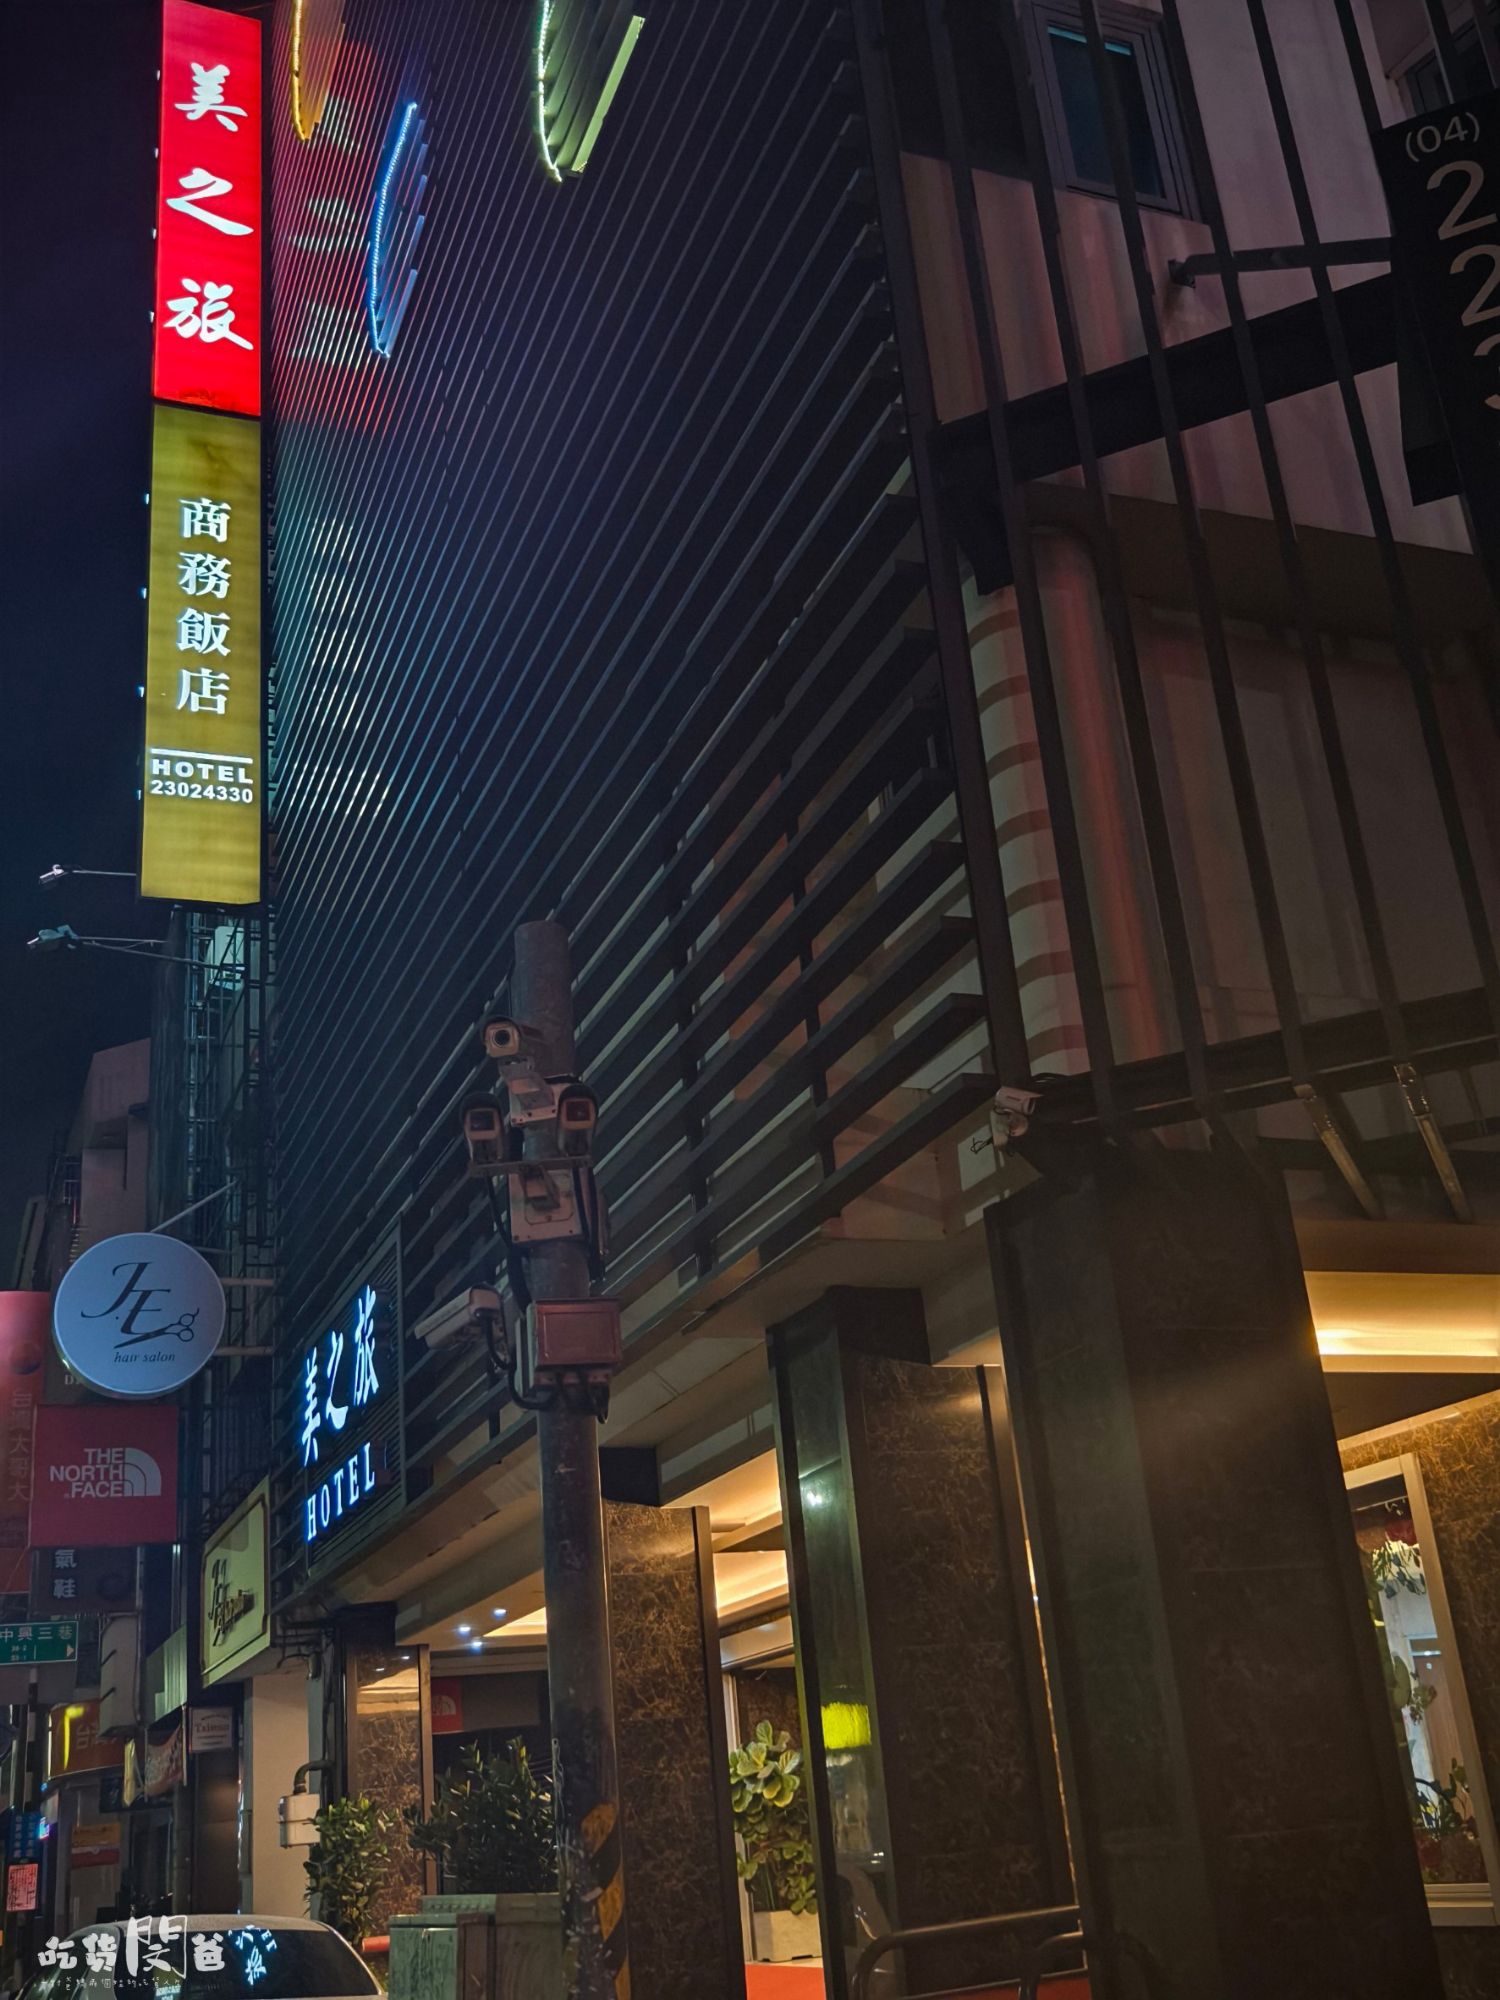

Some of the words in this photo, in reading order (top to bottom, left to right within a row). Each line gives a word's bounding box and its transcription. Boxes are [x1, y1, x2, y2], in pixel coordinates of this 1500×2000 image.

[1405, 112, 1480, 162] (04)
[163, 62, 254, 350] 美之旅
[176, 497, 231, 715] 商務飯店
[151, 758, 253, 784] HOTEL
[150, 779, 253, 803] 23024330
[113, 1351, 139, 1363] hair
[142, 1351, 175, 1363] salon
[302, 1285, 379, 1467] 美之旅
[84, 1448, 124, 1465] THE
[50, 1464, 124, 1482] NORTH
[71, 1480, 124, 1499] FACE
[307, 1442, 375, 1541] HOTEL
[0, 1625, 73, 1644] 中興三巷
